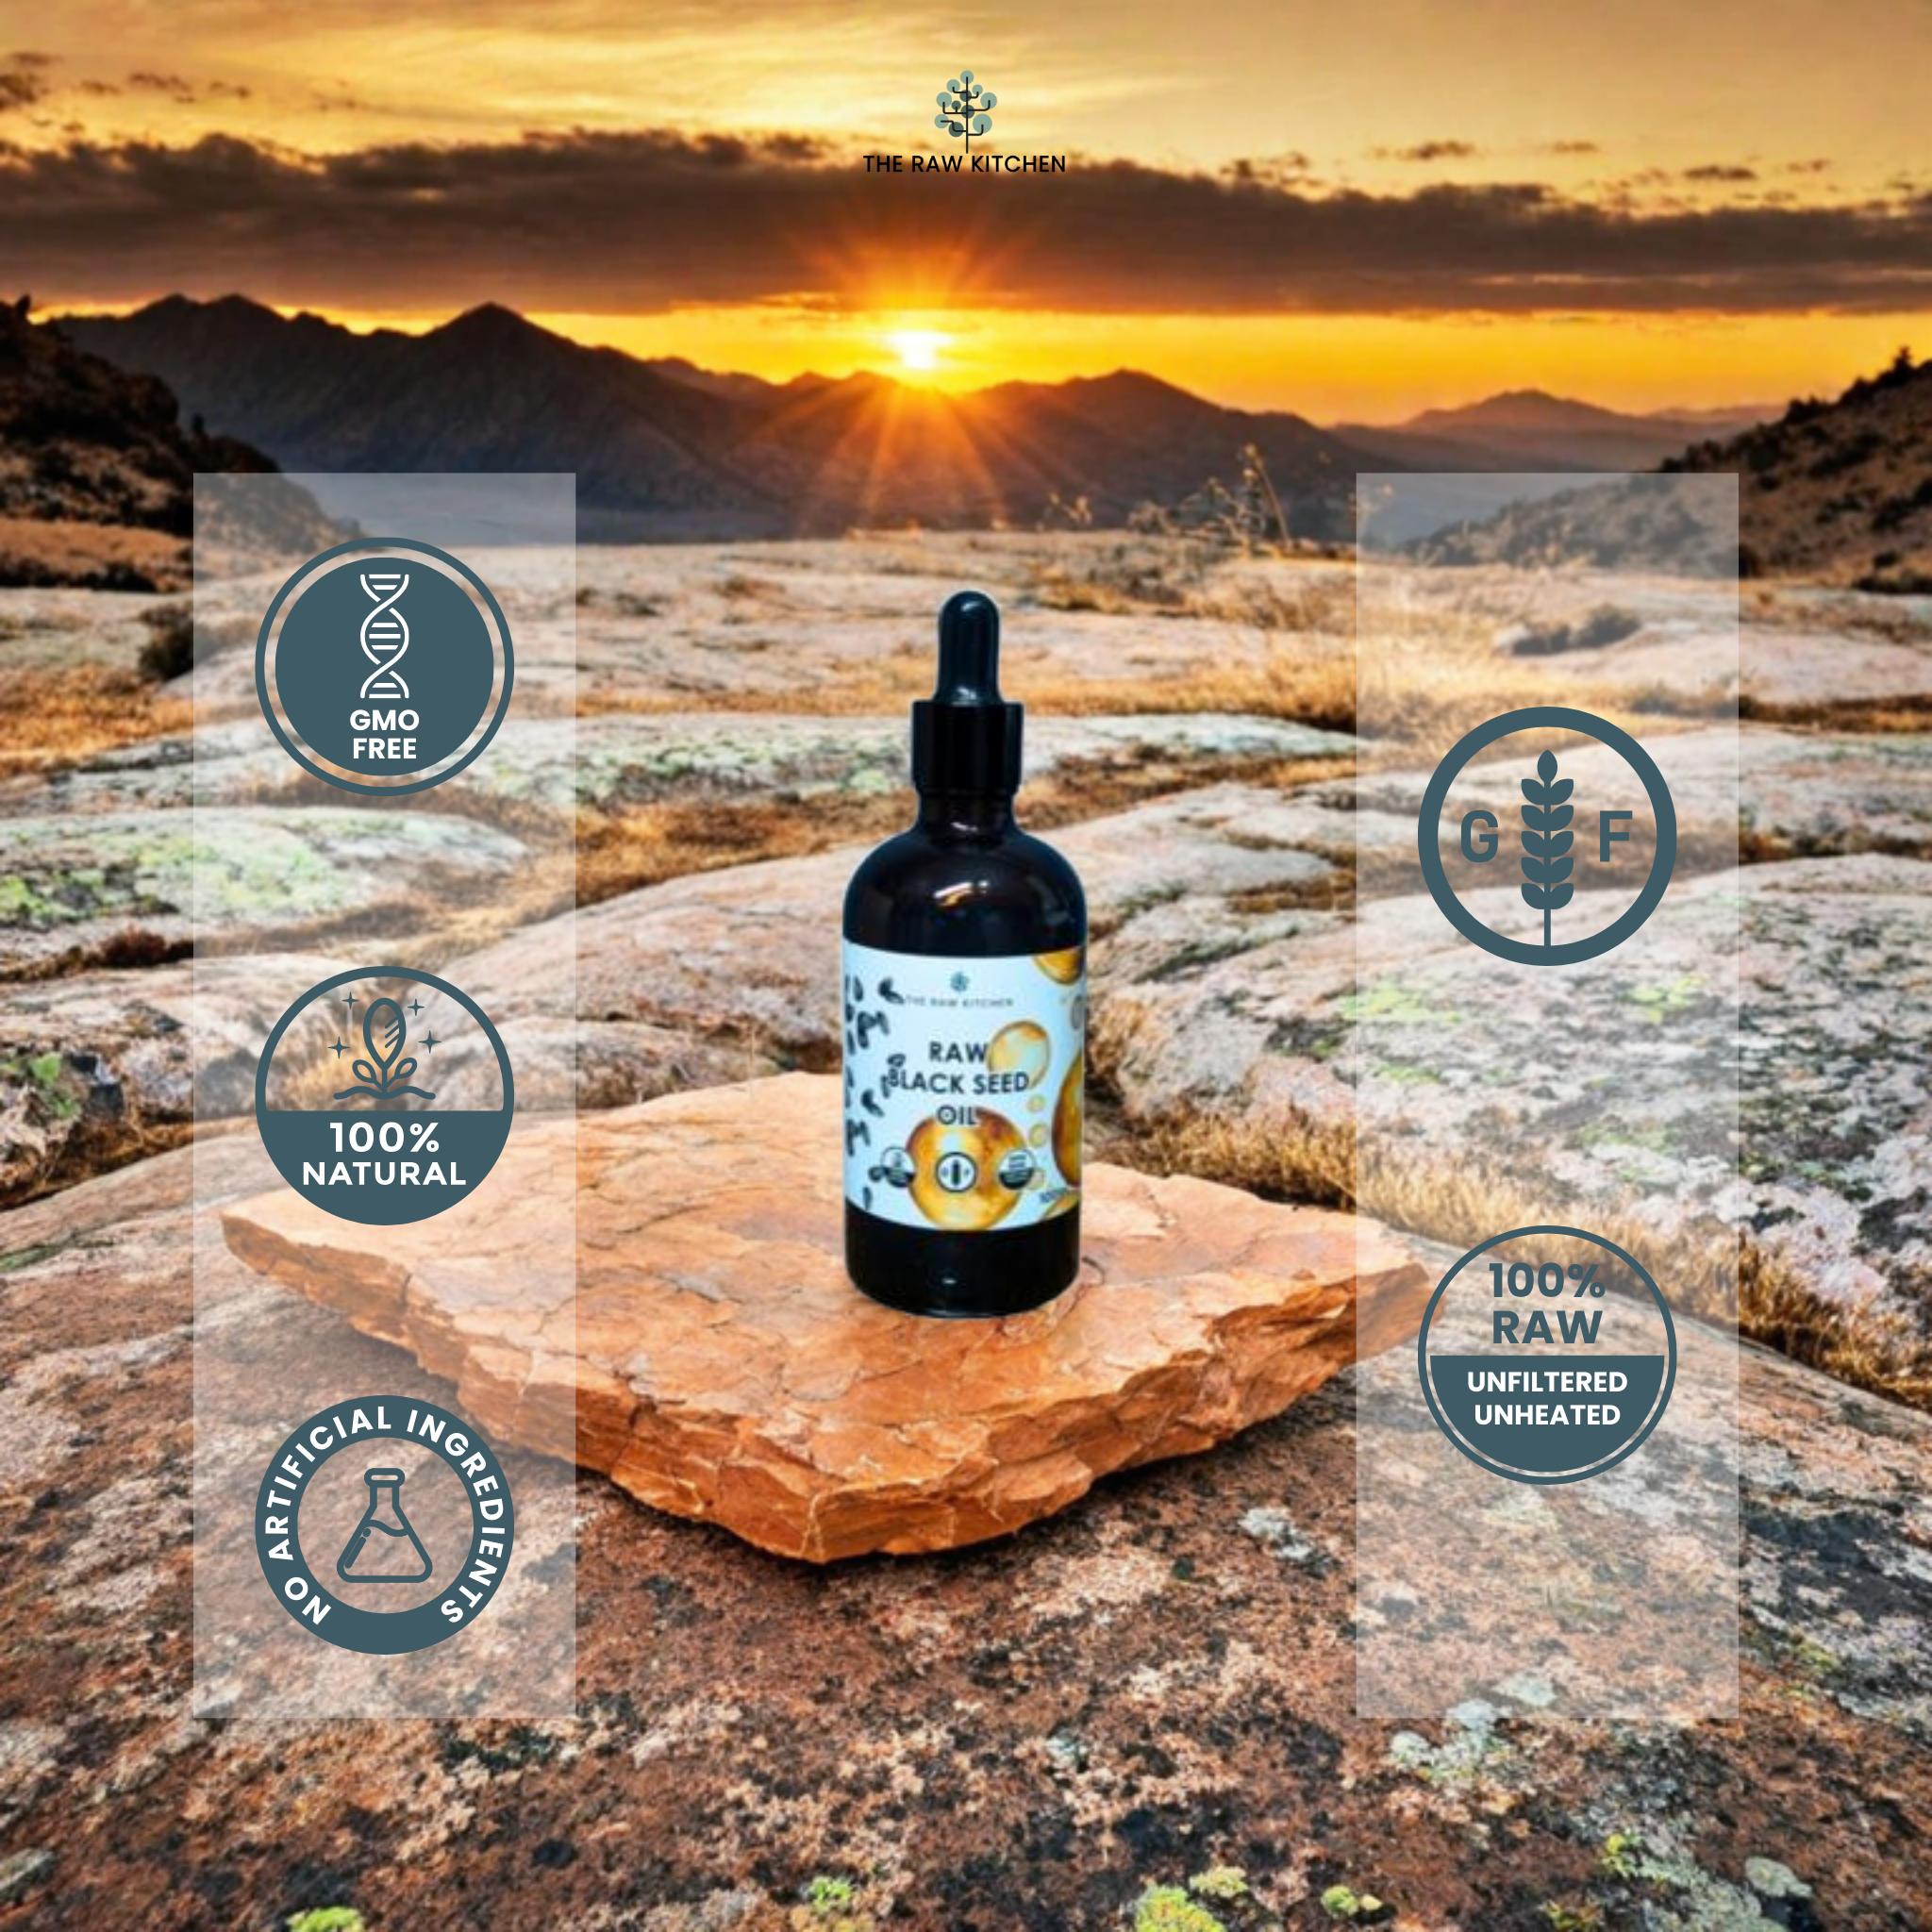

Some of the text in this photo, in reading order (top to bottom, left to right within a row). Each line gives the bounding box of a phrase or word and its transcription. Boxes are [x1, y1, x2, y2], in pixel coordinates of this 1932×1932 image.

[929, 1041, 988, 1062] RAW
[889, 1068, 1029, 1094] BLACK SEED
[937, 1105, 977, 1125] OIL
